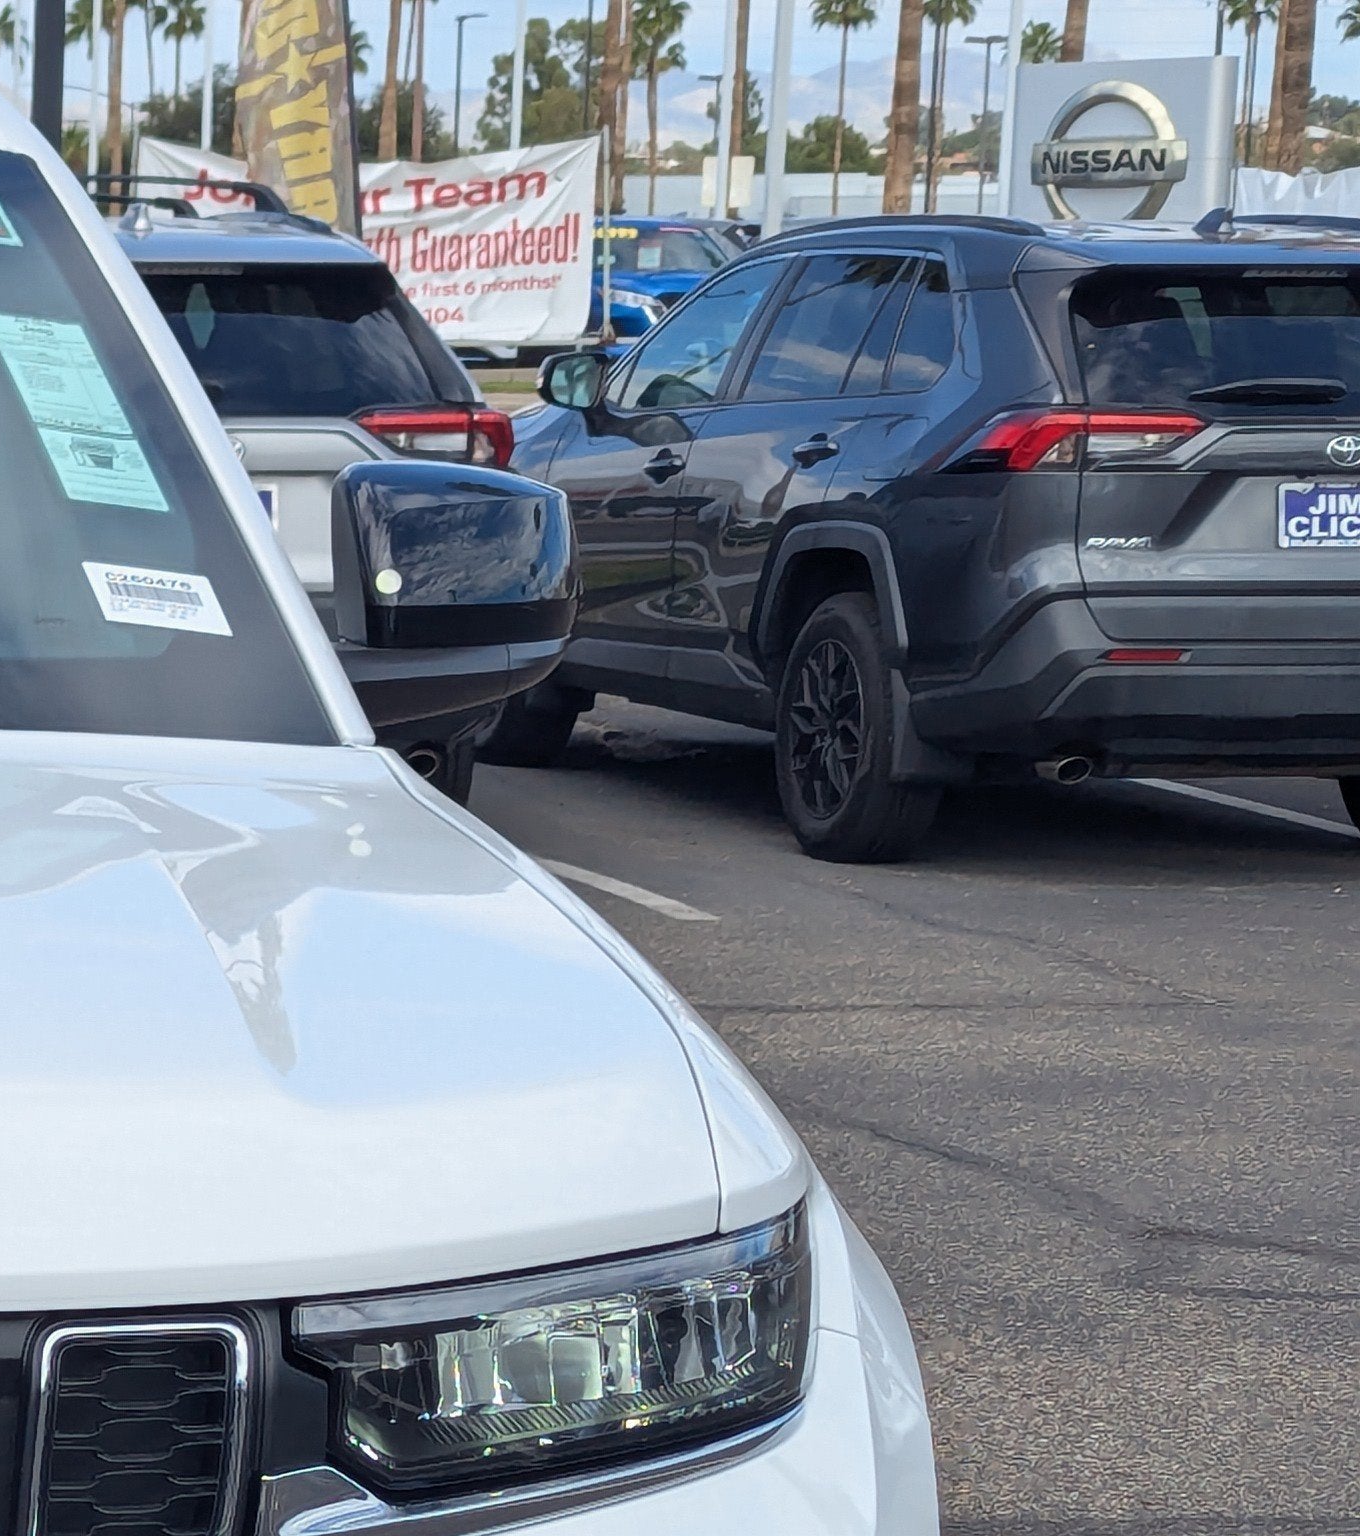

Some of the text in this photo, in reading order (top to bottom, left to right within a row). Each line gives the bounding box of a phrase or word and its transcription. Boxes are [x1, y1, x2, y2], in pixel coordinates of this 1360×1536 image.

[1042, 148, 1166, 174] NISSAN
[403, 170, 547, 213] Team
[411, 212, 581, 273] Guaranteed!
[422, 280, 461, 297] first
[464, 280, 476, 297] 6
[1308, 493, 1360, 515] JIM
